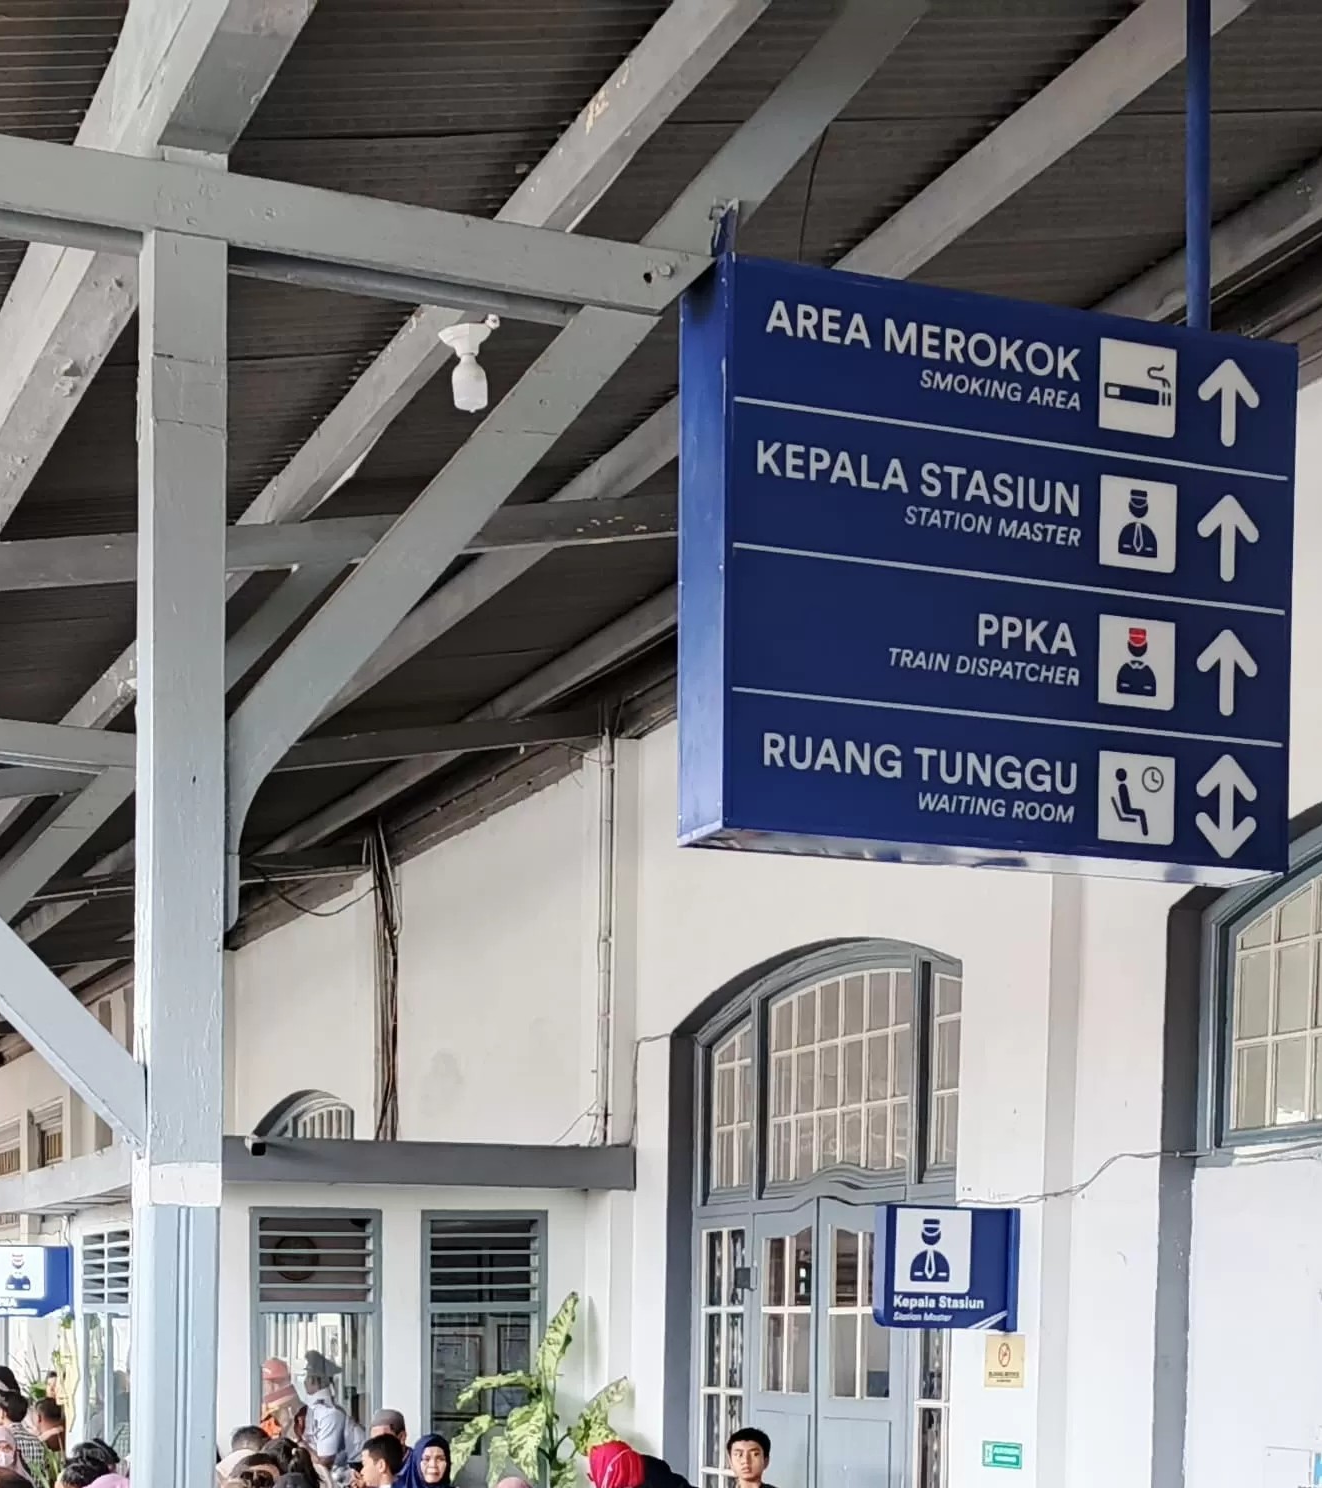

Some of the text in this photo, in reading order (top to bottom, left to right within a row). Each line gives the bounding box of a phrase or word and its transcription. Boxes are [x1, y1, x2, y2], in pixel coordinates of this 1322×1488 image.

[765, 300, 1080, 381] AREA MEROKOK
[920, 369, 1081, 411] SMOKING AREA
[757, 439, 1079, 517] KEPALA STASIUN
[904, 505, 1081, 546] STATION MASTER
[978, 613, 1077, 657] PPKA
[889, 647, 1080, 687] TRAIN DISPATCHER
[763, 732, 1078, 796] RUANG TUNGGU
[918, 792, 1075, 824] WAITING ROOM
[893, 1294, 985, 1311] Kepala Stasiun
